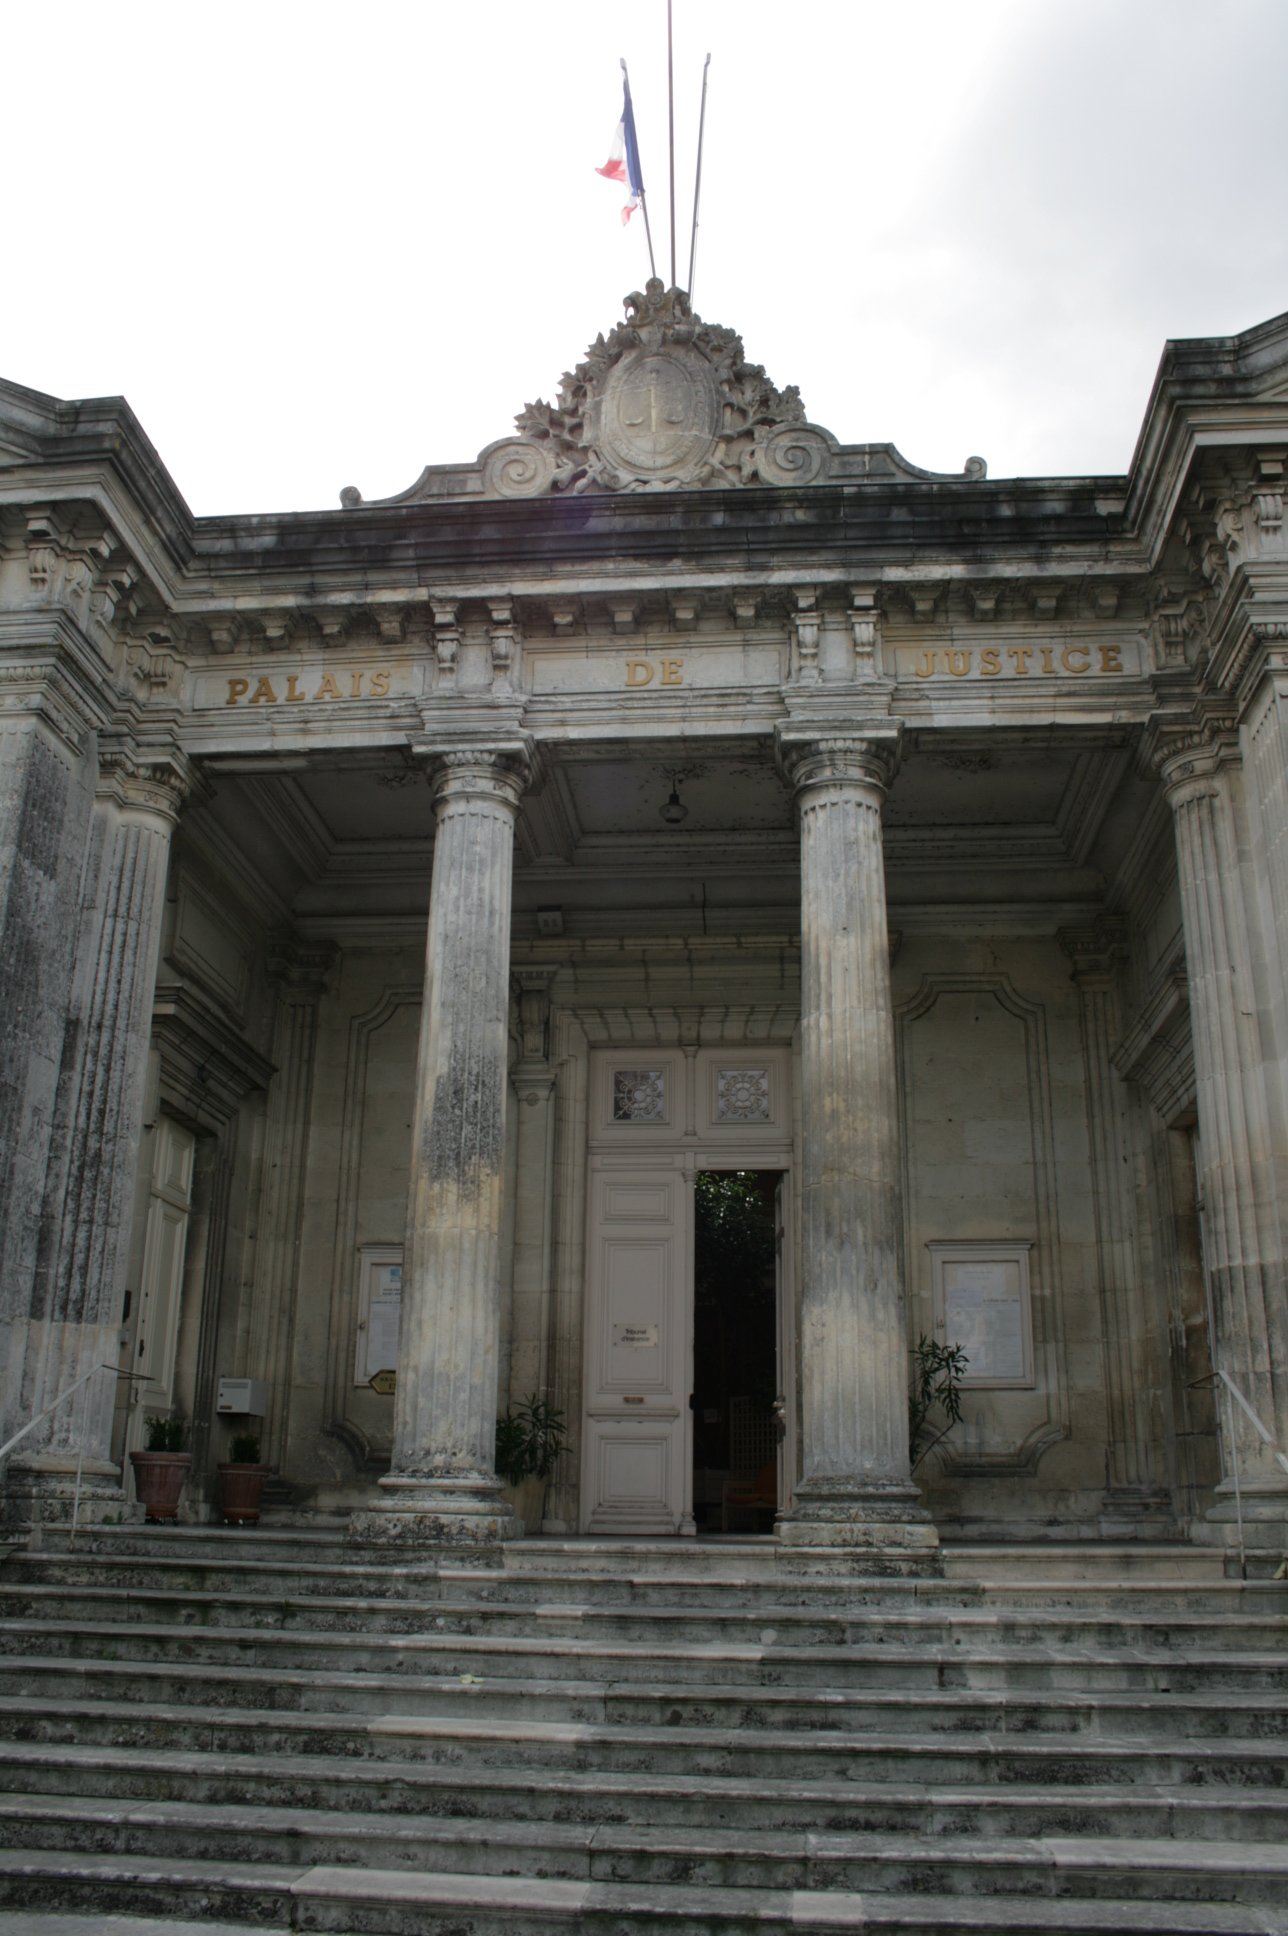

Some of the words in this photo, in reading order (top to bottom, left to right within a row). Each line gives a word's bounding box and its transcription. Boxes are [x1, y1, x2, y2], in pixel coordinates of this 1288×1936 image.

[226, 671, 391, 705] PALAIS
[625, 657, 684, 687] DE
[915, 644, 1122, 678] JUSTICE
